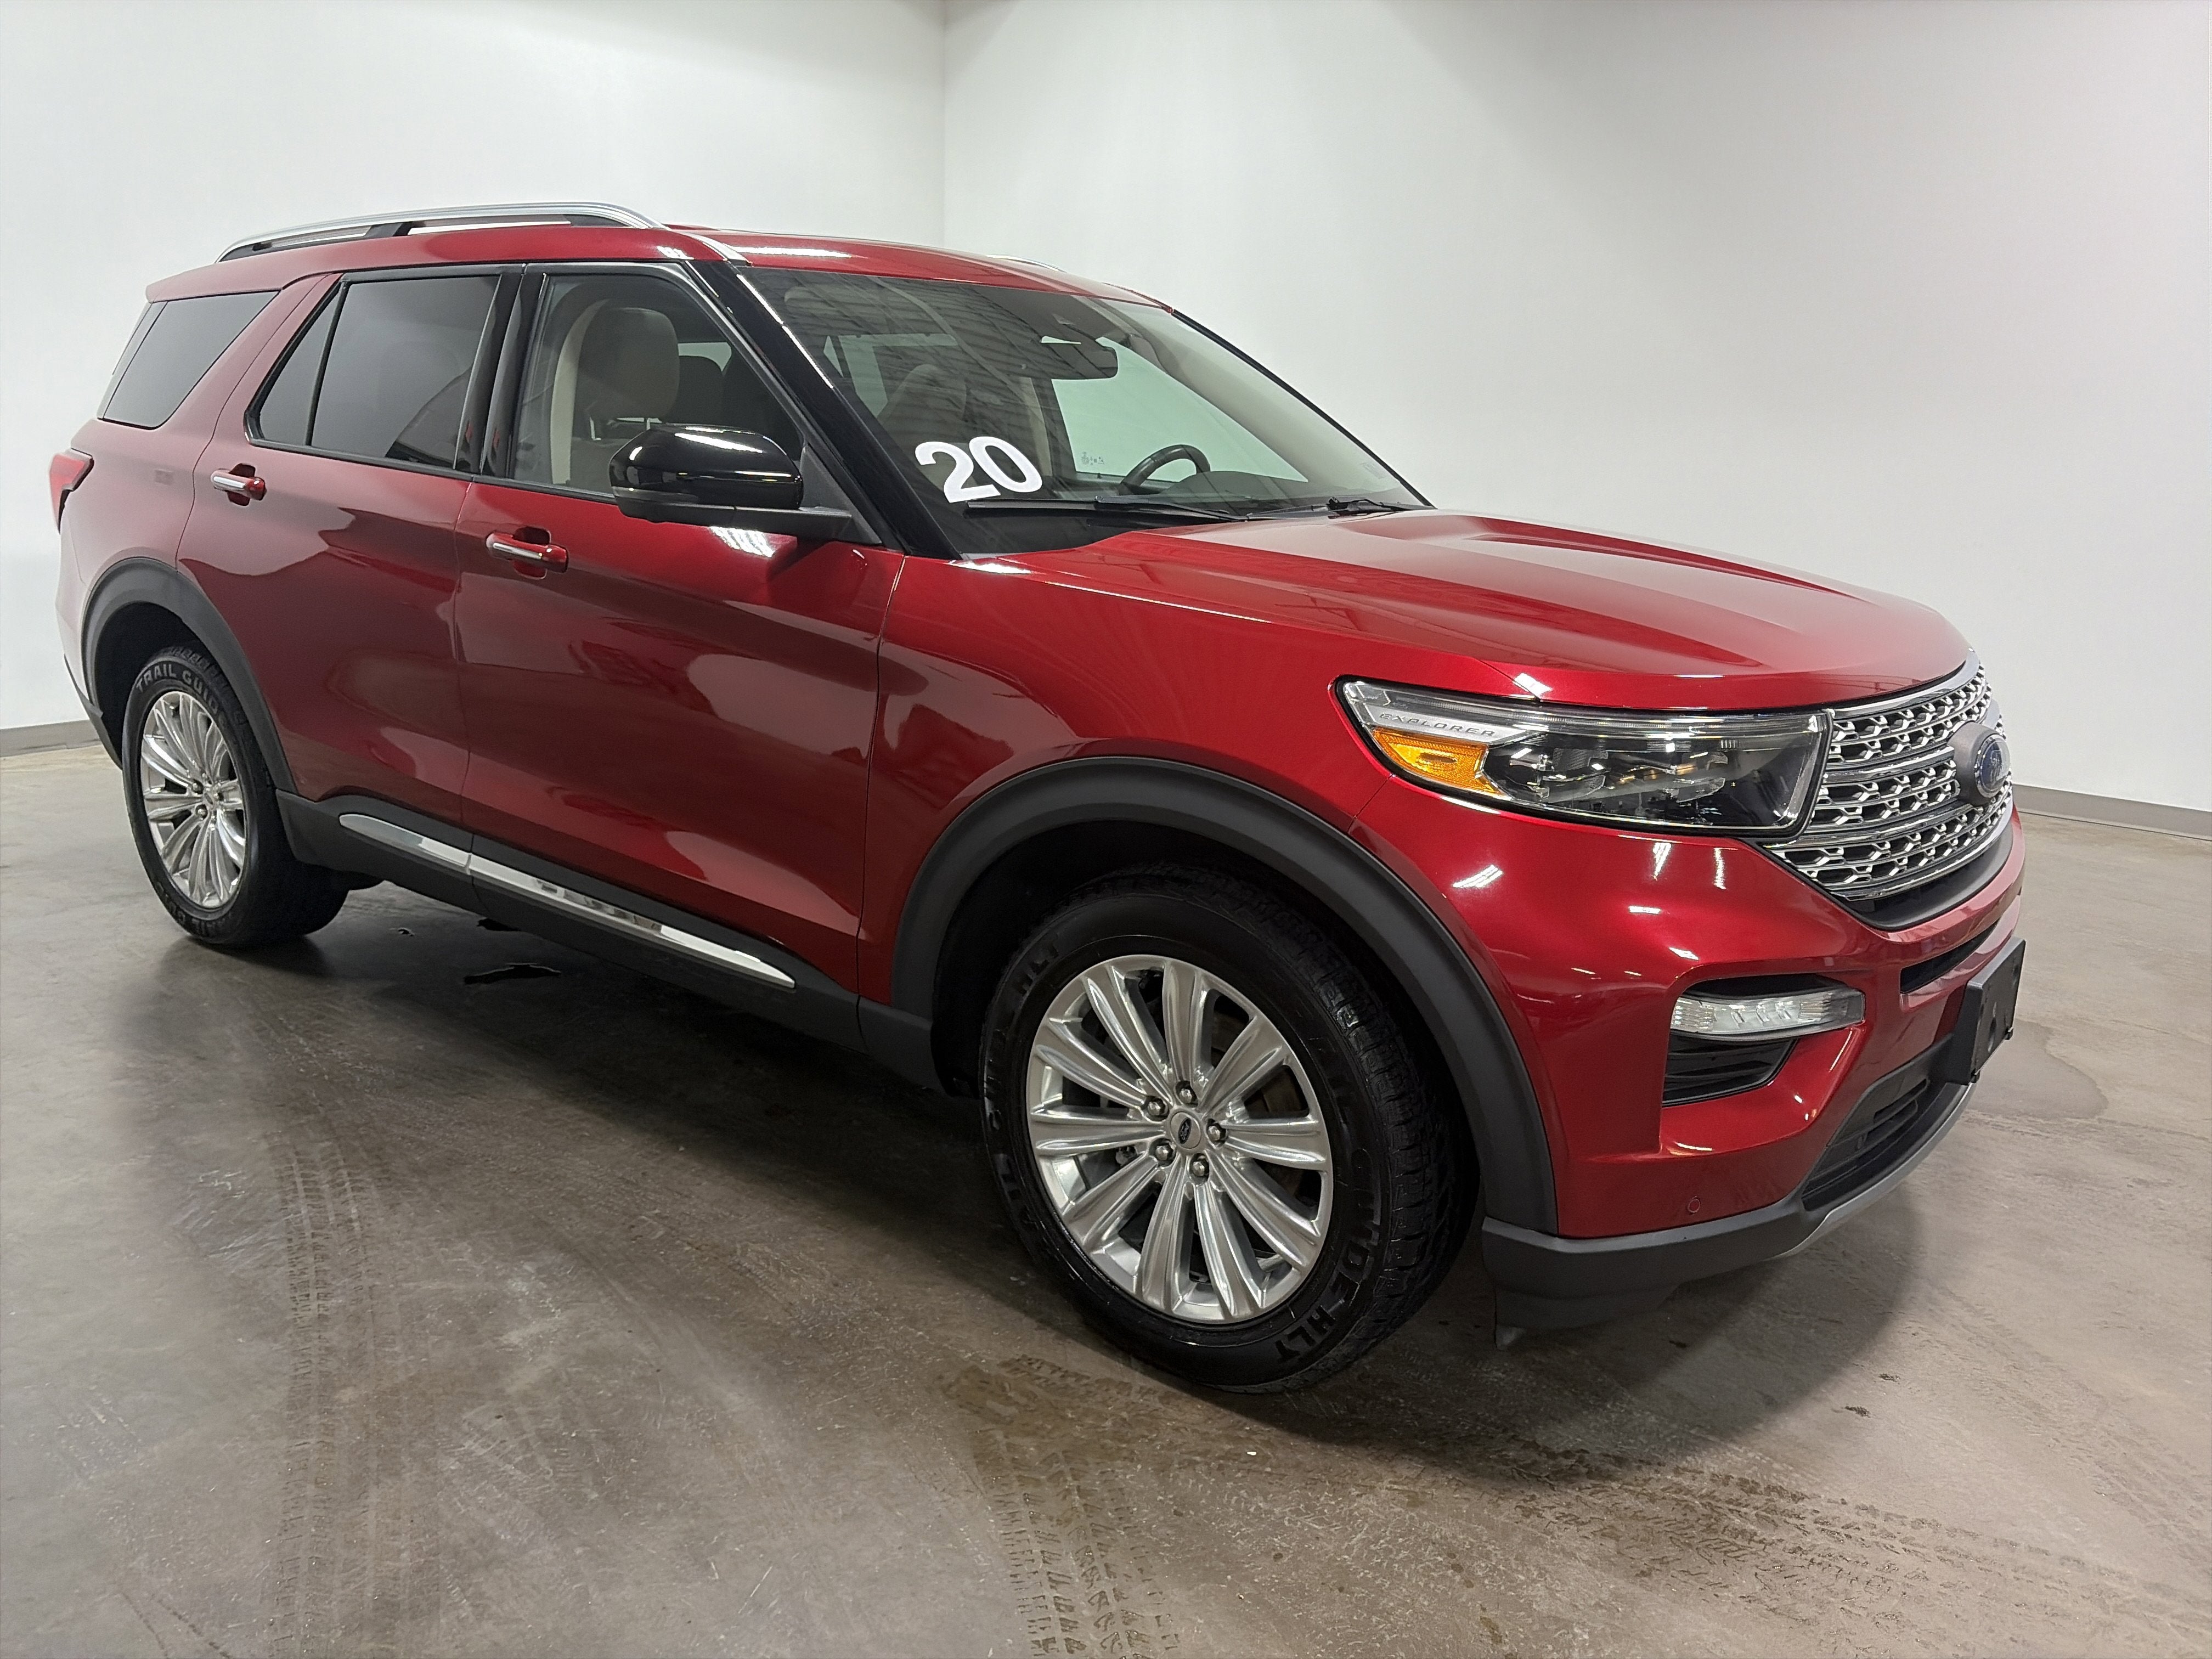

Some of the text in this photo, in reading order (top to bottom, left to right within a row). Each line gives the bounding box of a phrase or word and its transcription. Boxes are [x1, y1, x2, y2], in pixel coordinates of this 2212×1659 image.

[915, 436, 1042, 503] 20
[136, 663, 177, 693] TRAIL
[1379, 712, 1496, 737] EXPLORER
